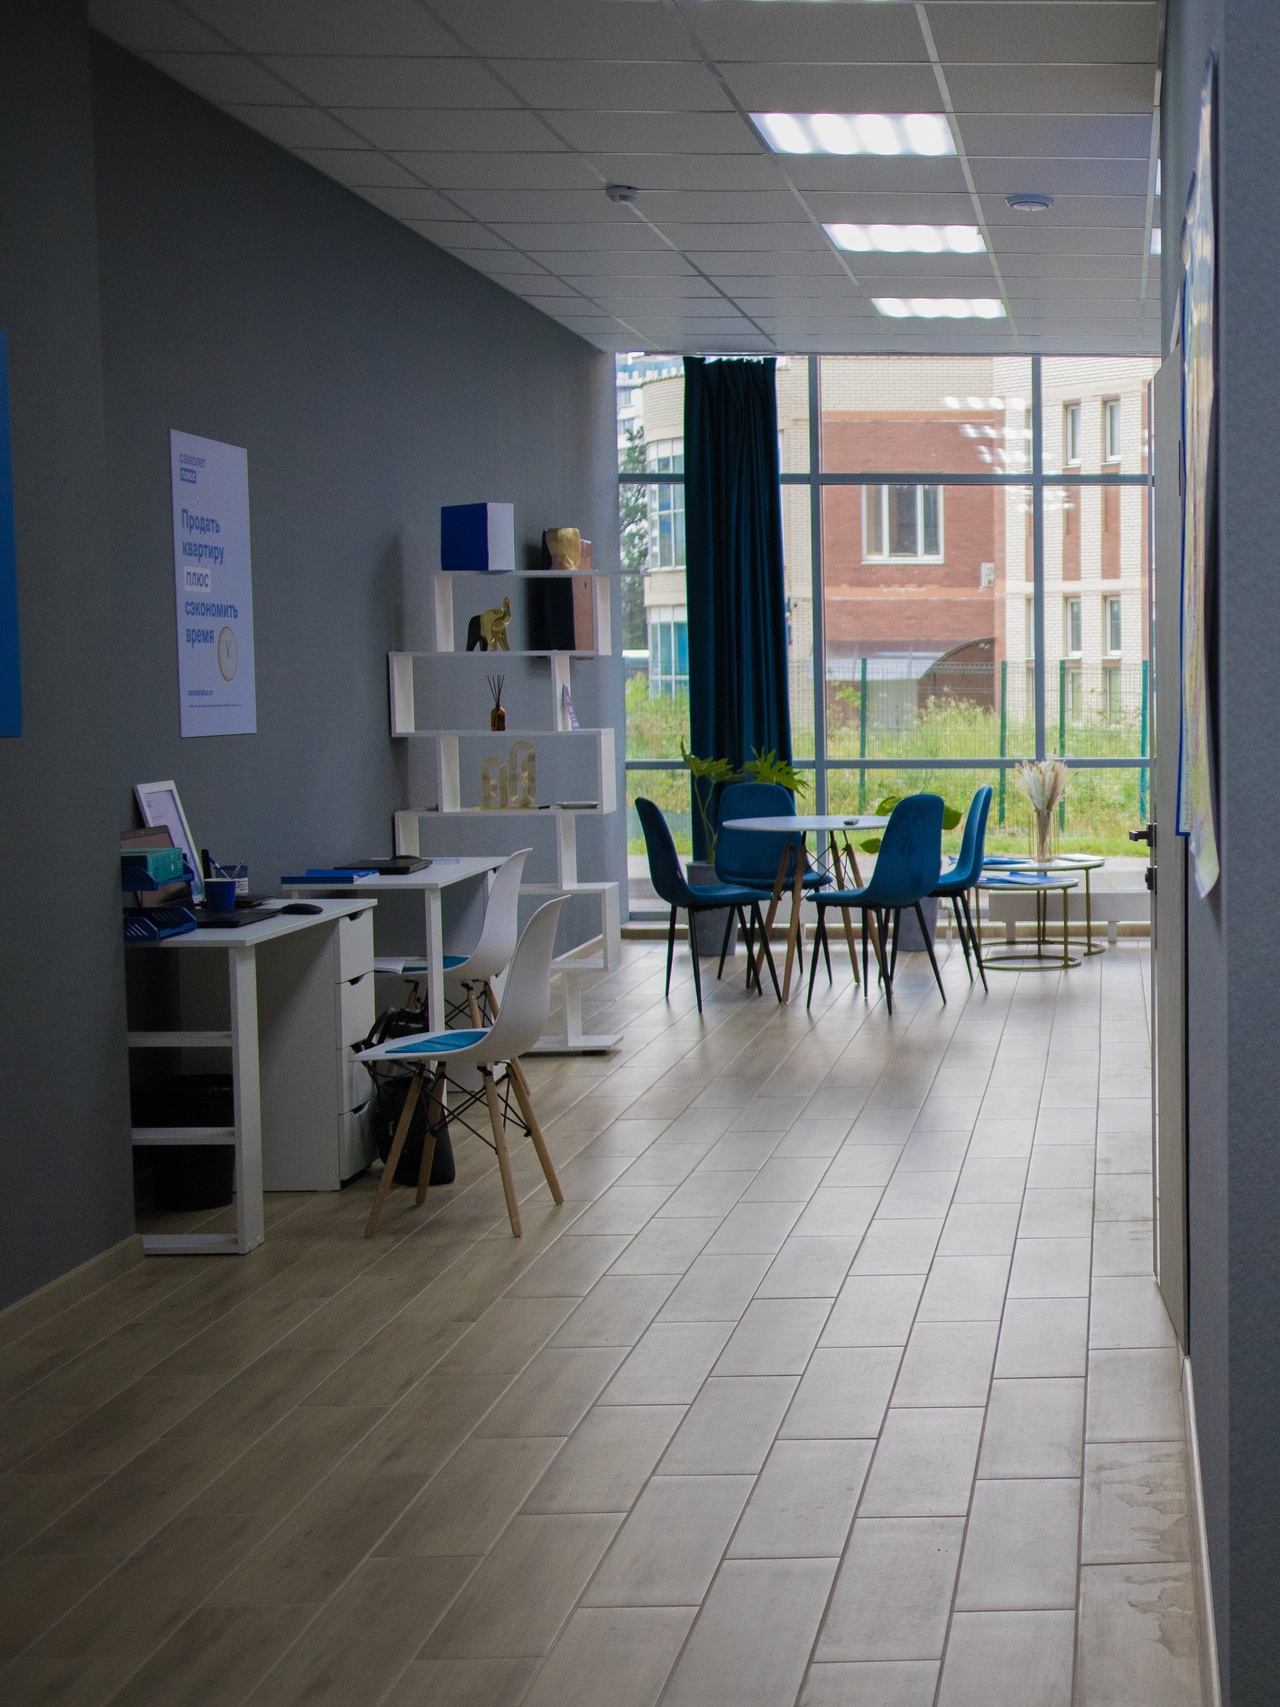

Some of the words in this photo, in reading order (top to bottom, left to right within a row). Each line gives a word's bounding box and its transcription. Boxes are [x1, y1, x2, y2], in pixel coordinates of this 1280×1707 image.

[181, 508, 220, 534] Продать
[182, 541, 225, 565] квартиру
[186, 571, 210, 588] плюс
[185, 601, 238, 619] сэкономить
[186, 629, 215, 648] время
